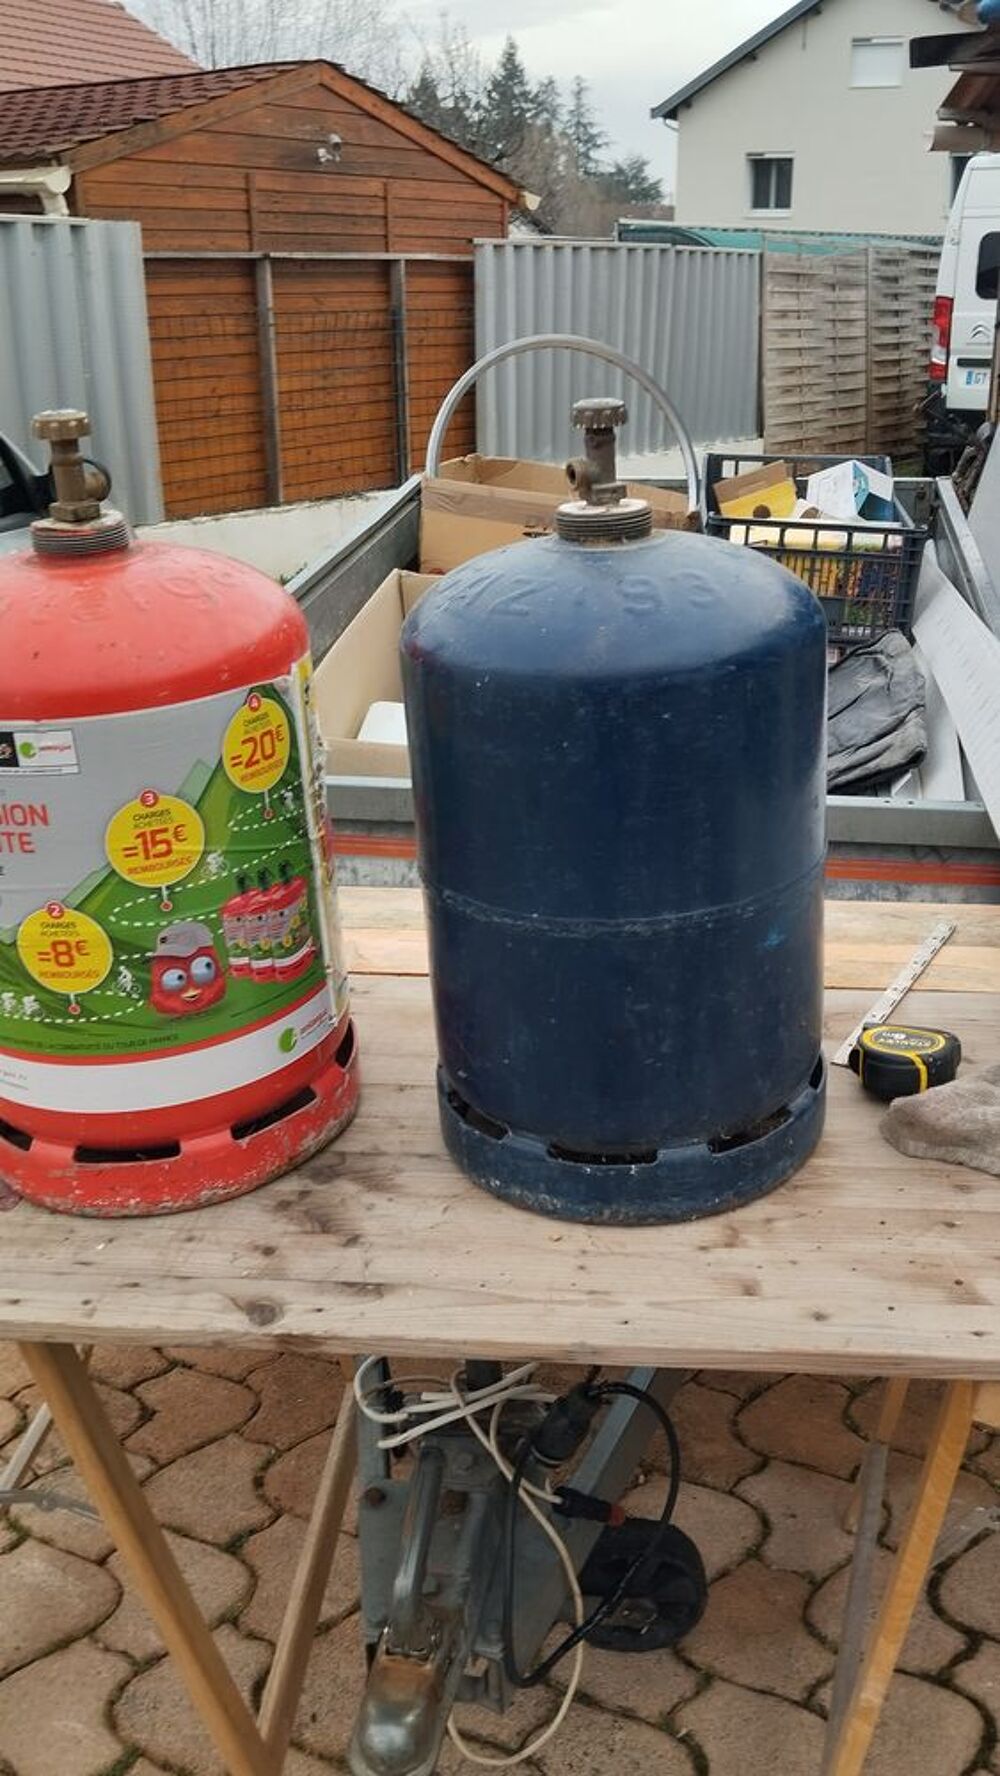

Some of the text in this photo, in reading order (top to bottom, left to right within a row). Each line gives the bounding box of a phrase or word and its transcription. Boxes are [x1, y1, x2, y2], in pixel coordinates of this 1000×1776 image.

[143, 792, 155, 806] 3
[0, 804, 50, 827] ION
[0, 831, 35, 853] TE
[50, 904, 62, 917] 2
